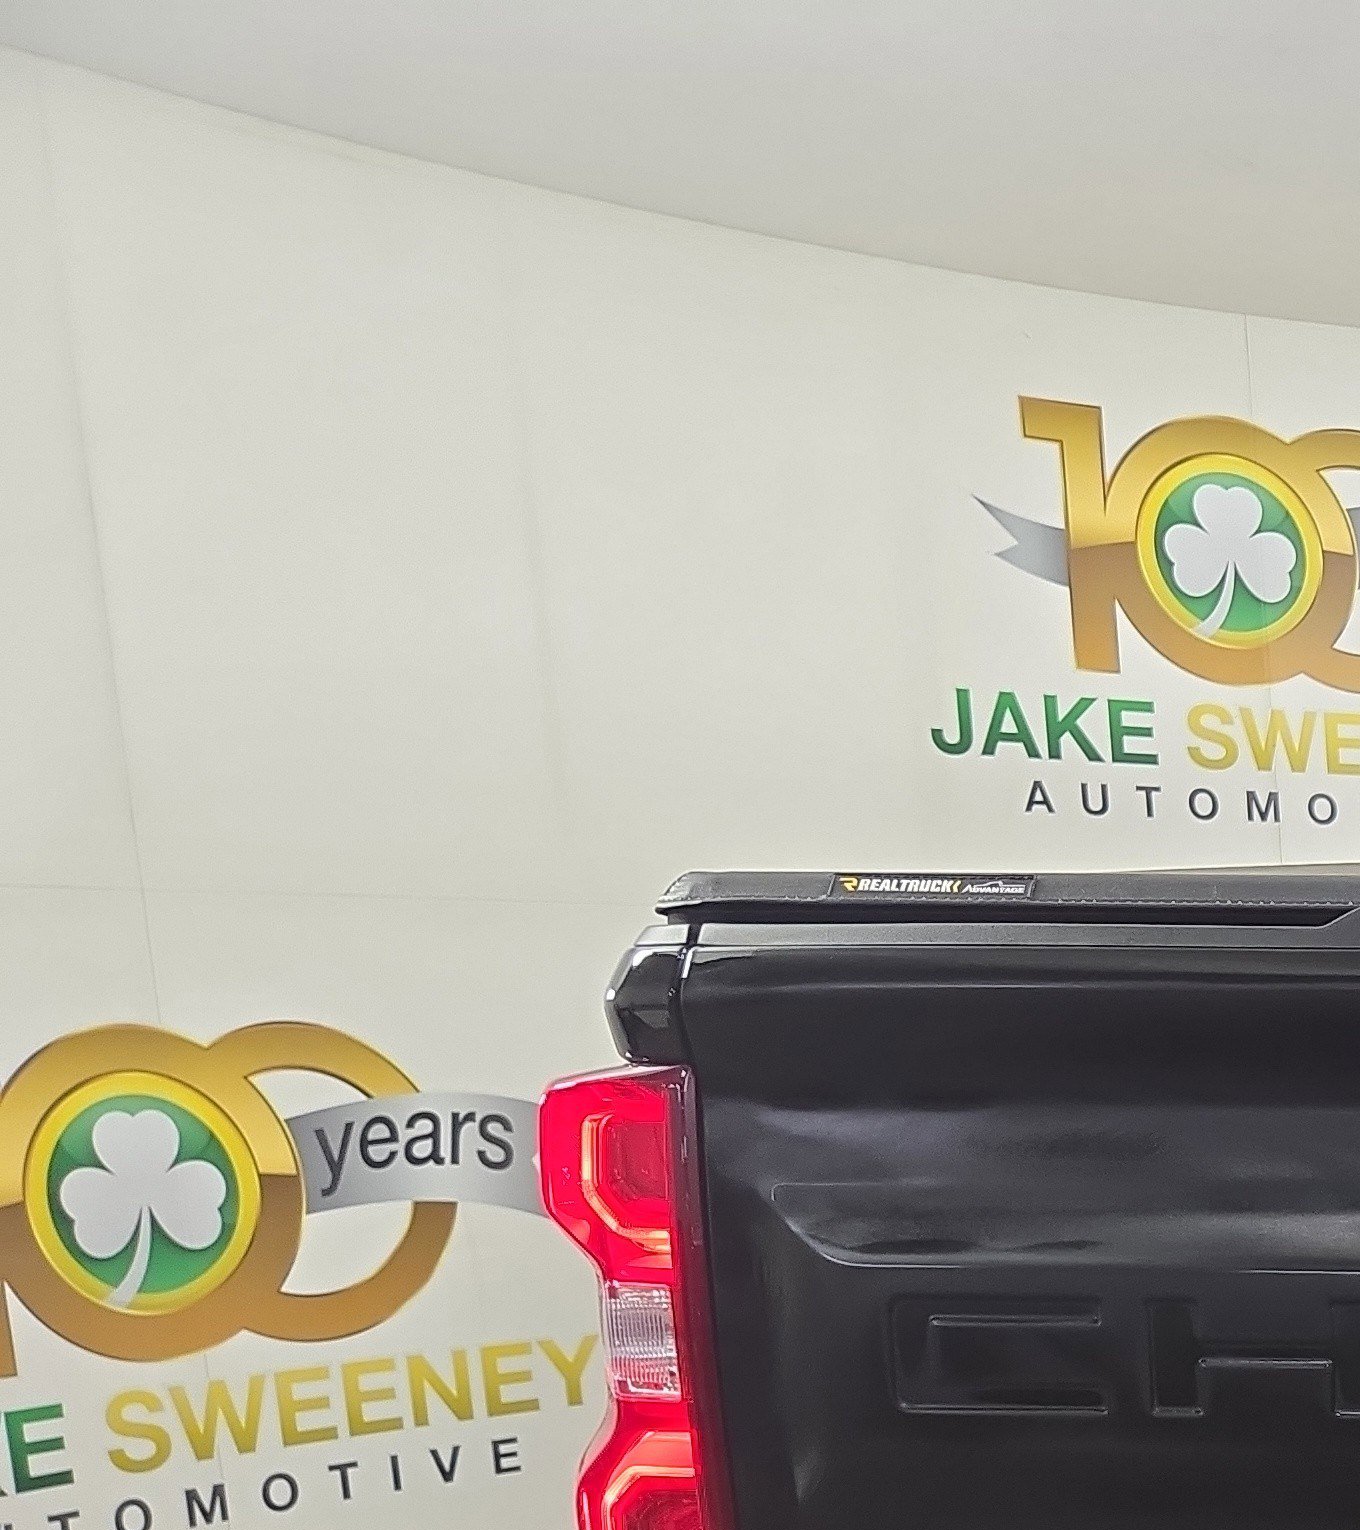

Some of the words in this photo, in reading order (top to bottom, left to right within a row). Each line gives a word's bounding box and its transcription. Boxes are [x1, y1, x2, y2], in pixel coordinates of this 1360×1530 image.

[930, 688, 1160, 766] JAKE
[857, 878, 951, 893] REALTRUCK
[313, 1110, 515, 1197] years
[0, 1402, 75, 1496] E
[105, 1332, 599, 1474] SWEENEY
